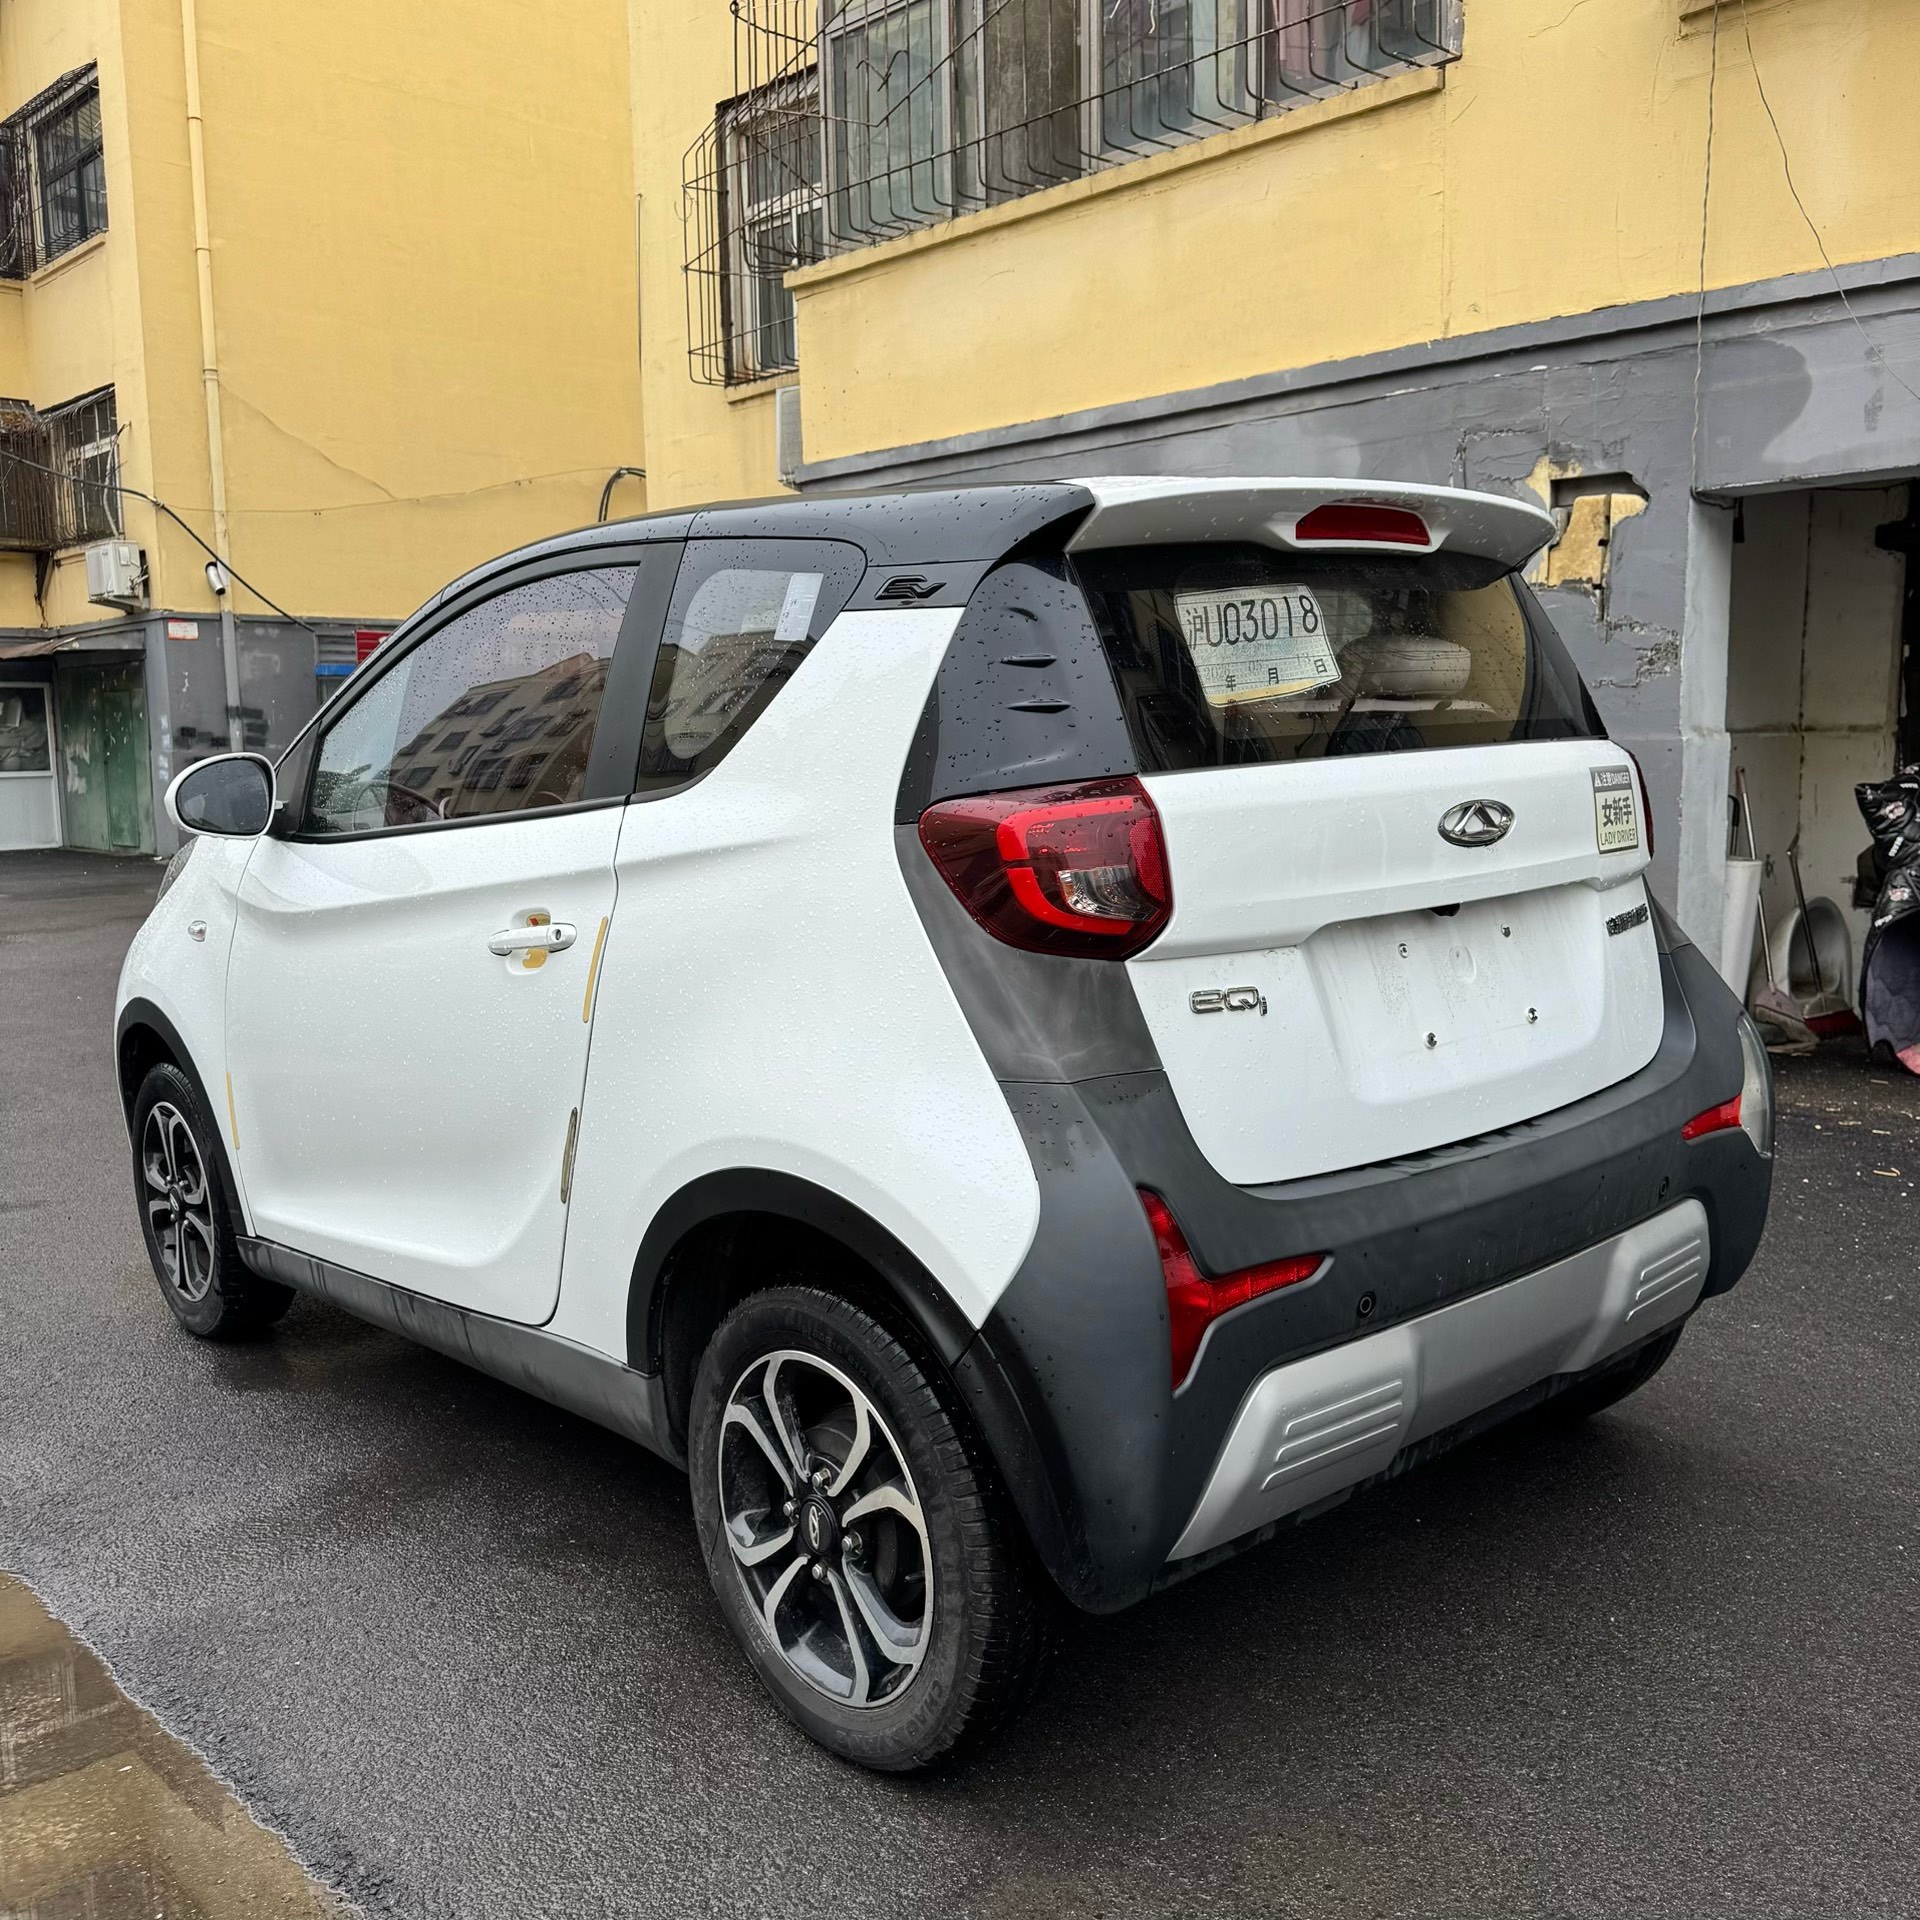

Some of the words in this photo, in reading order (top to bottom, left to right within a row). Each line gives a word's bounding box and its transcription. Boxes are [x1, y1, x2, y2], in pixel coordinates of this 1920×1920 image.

[874, 575, 947, 600] EV
[1186, 595, 1319, 650] 沪U03018
[1268, 667, 1279, 685] 月
[1314, 658, 1328, 675] 日
[1601, 796, 1632, 827] 女新手
[1600, 831, 1616, 845] LADY
